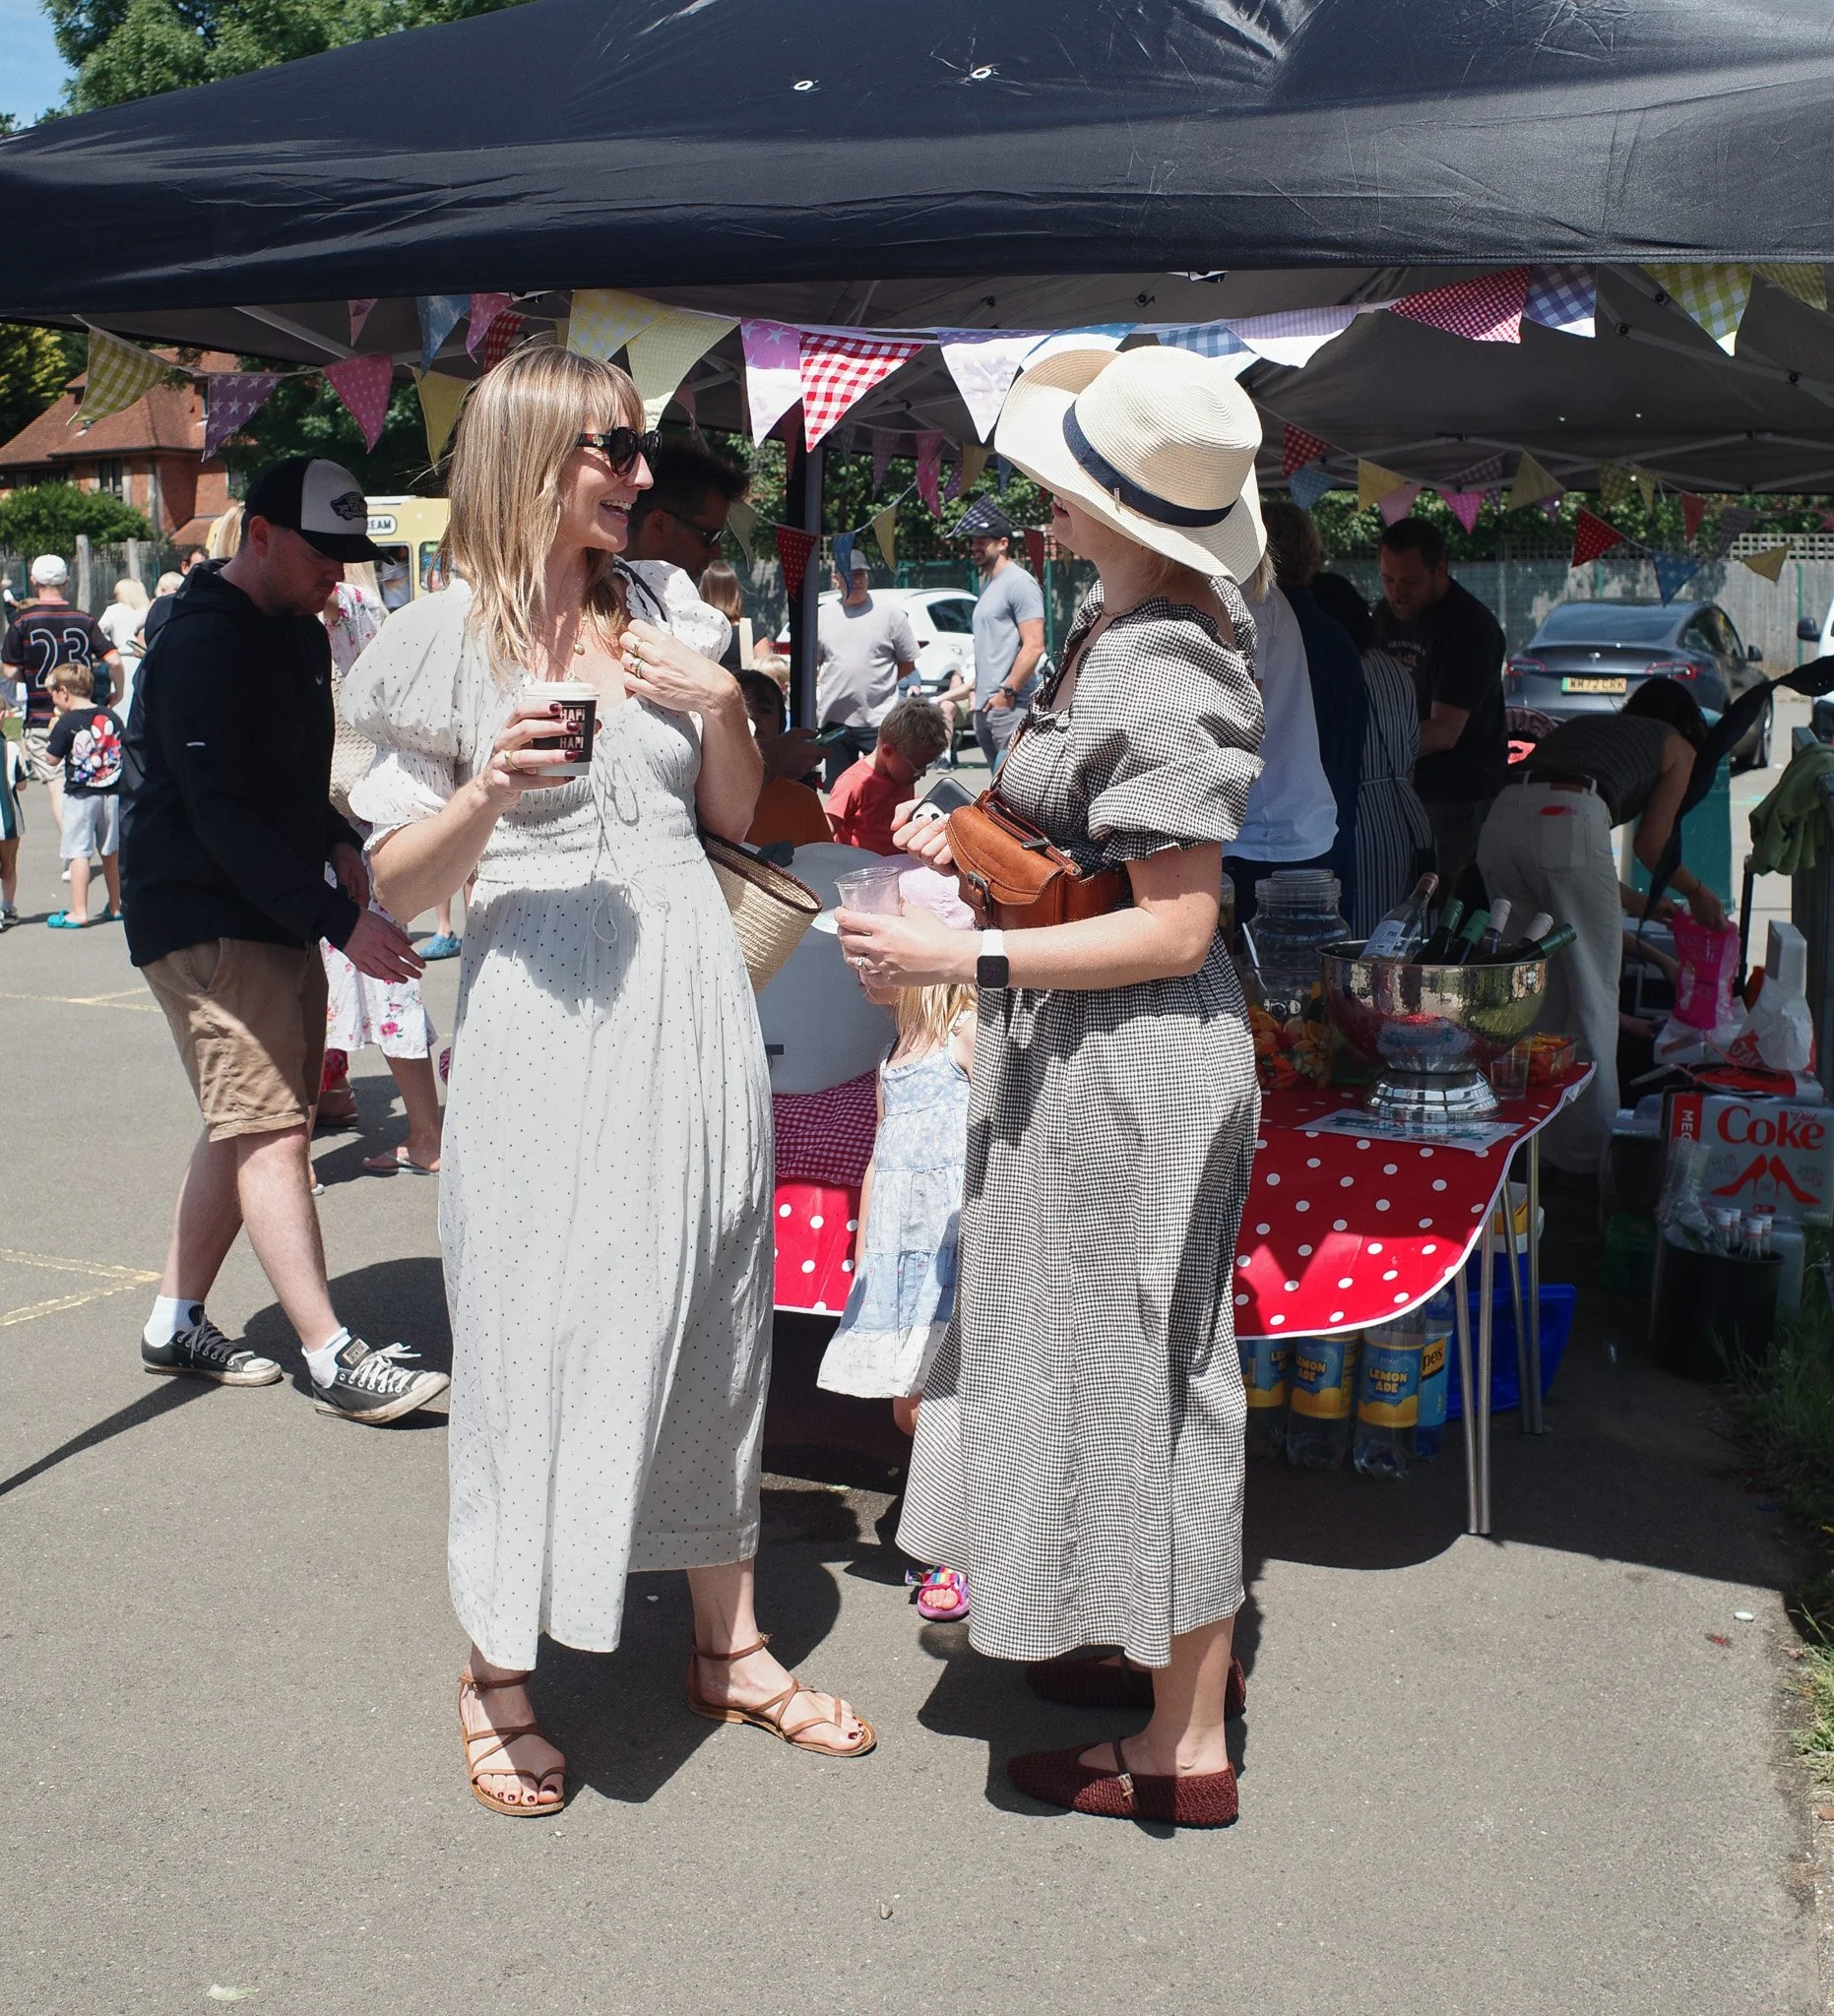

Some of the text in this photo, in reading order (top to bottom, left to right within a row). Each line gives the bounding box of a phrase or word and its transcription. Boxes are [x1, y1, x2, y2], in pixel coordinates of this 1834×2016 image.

[31, 628, 91, 688] 23
[559, 736, 584, 749] HAPI
[1717, 1105, 1825, 1151] Coke
[1296, 1354, 1326, 1373] LEMON
[1369, 1367, 1408, 1382] LEMON
[1375, 1381, 1398, 1393] ADE
